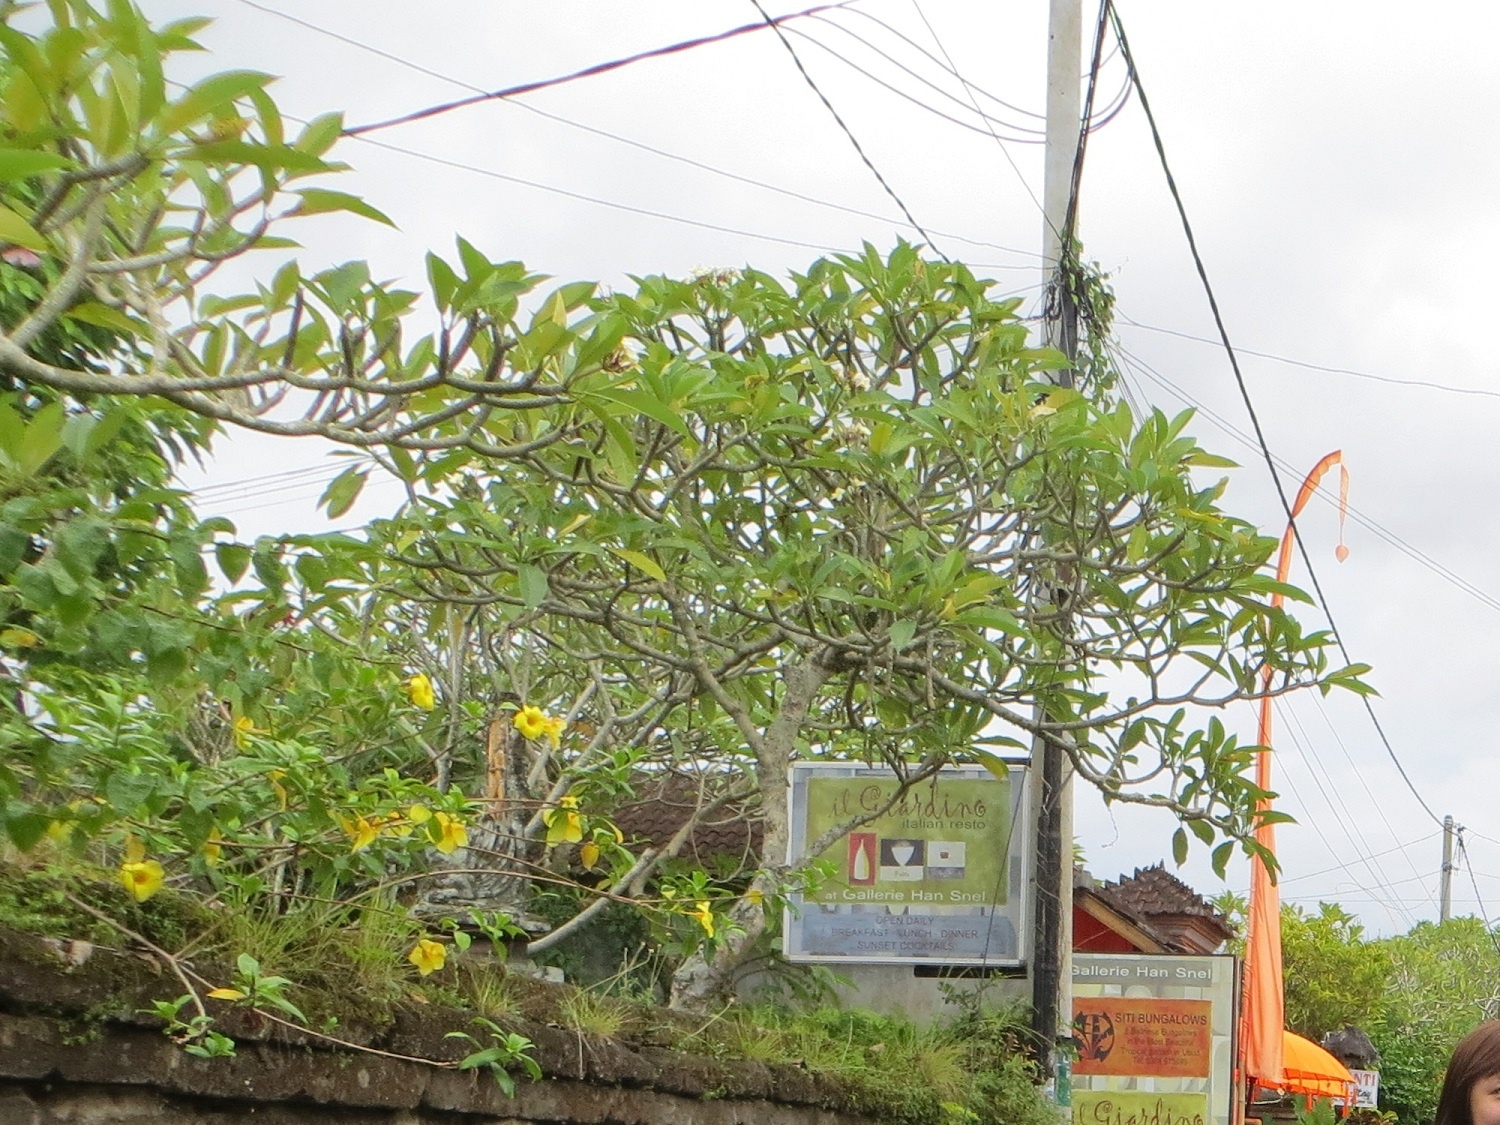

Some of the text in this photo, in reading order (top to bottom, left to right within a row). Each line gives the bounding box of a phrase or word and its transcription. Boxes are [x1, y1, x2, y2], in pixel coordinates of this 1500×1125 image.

[902, 819, 986, 830] italian resto
[825, 889, 986, 902] at Gallerie Han Snel
[875, 916, 934, 926] OPEN DAILY
[832, 928, 978, 939] BREAKFAST LUNCH DINNER
[857, 940, 955, 951] SUNSET COCKTAILS
[1136, 966, 1168, 978] Han
[1176, 967, 1212, 979] Snel
[1115, 1012, 1207, 1026] SITI BUNGALOWS
